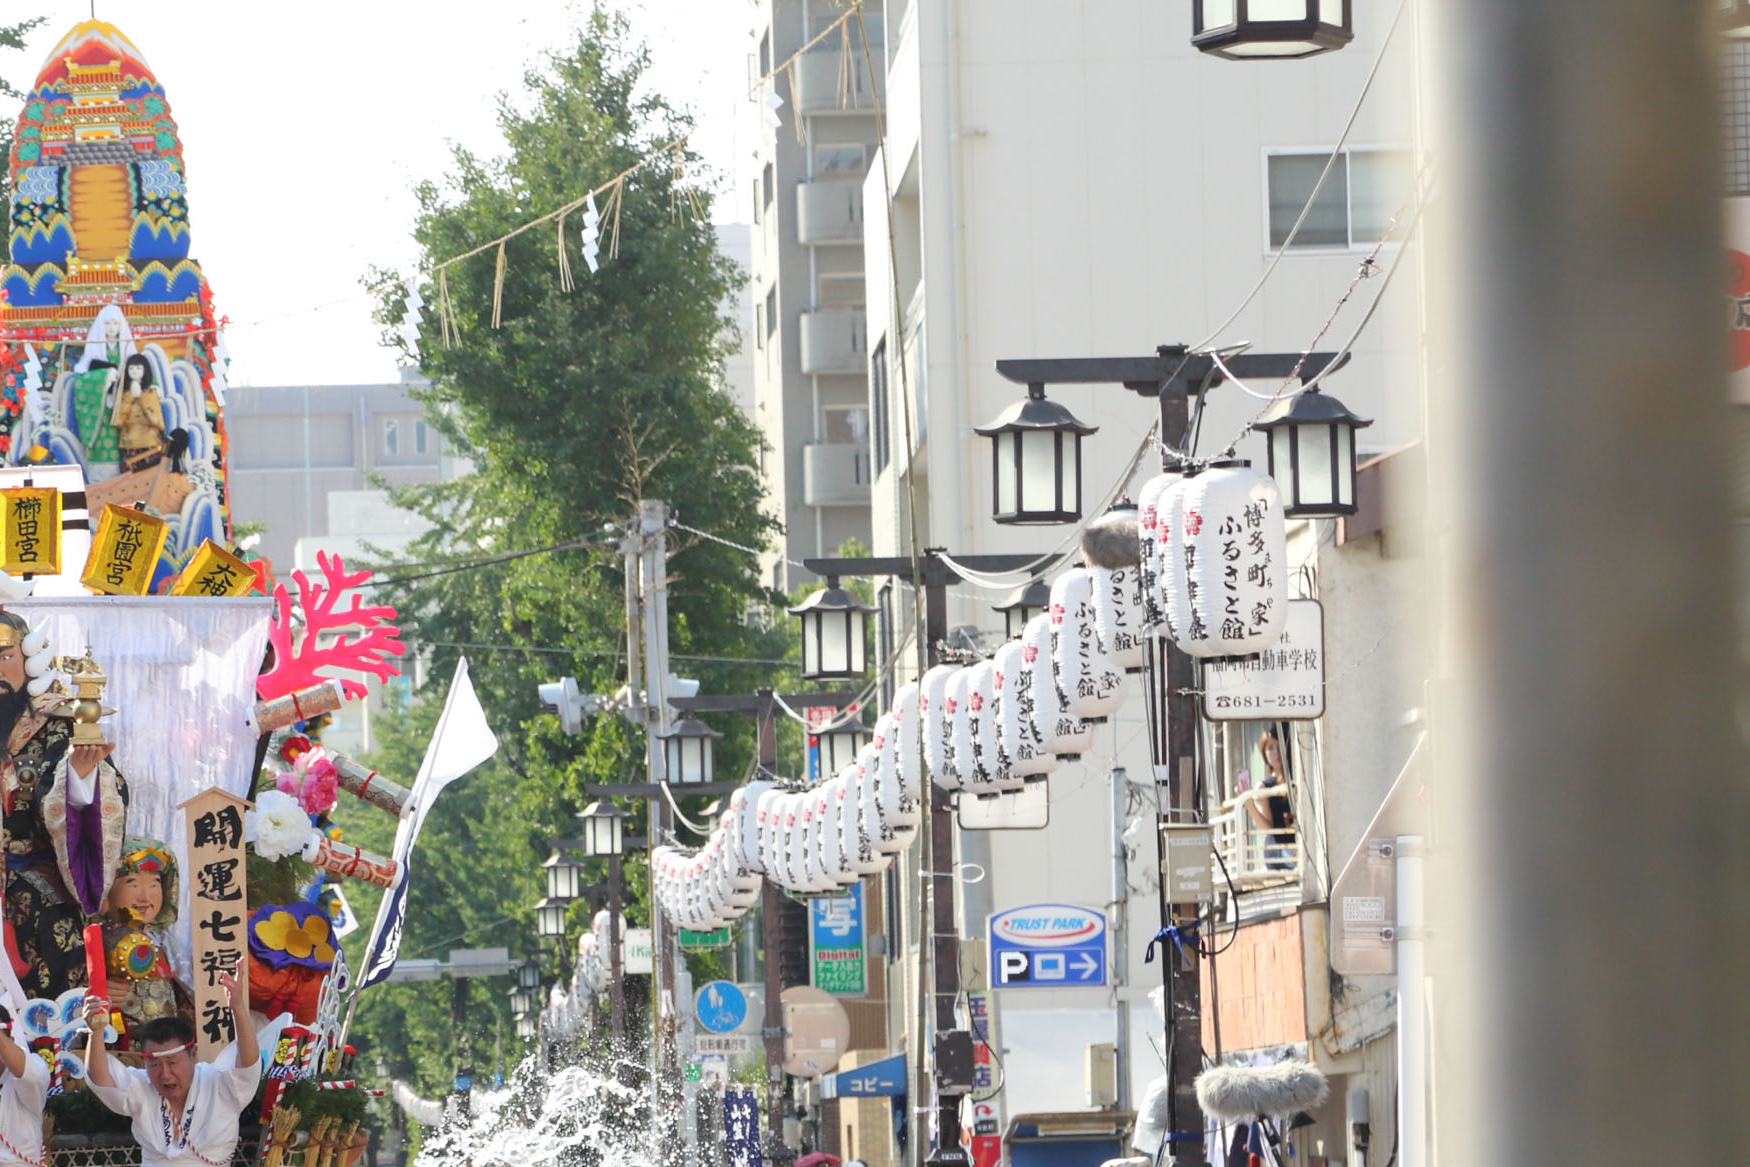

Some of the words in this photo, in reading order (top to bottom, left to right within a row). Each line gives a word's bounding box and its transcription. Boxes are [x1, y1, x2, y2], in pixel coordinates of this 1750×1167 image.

[12, 497, 41, 563] 櫛田宮
[107, 520, 144, 587] 祇園宮
[1110, 569, 1133, 652] るさと館
[1219, 515, 1245, 640] ふるさと館
[193, 805, 244, 1045] 開運七福神
[818, 950, 860, 961] Digital
[1009, 918, 1050, 931] TRUST
[1052, 917, 1086, 930] PARK
[1000, 951, 1028, 984] P
[850, 1077, 894, 1093] コピー
